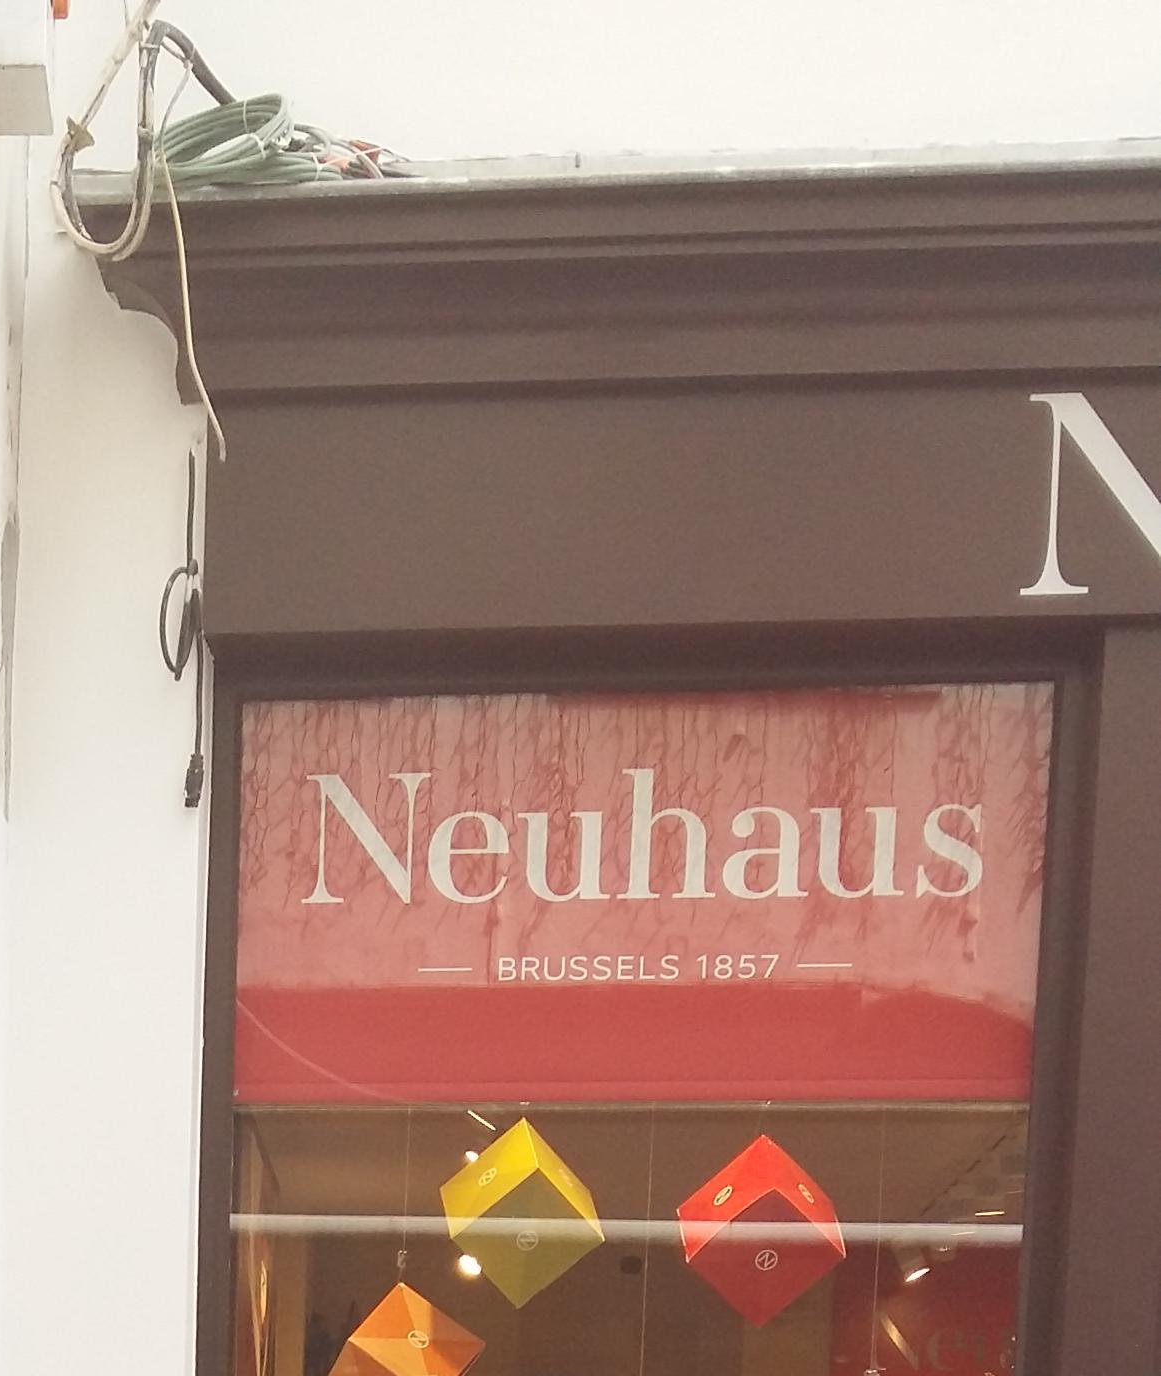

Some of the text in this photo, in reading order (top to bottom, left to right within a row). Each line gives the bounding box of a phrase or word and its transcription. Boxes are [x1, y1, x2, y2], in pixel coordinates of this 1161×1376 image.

[300, 767, 984, 904] Neuhaus
[496, 953, 781, 982] BRUSSELS 1857
